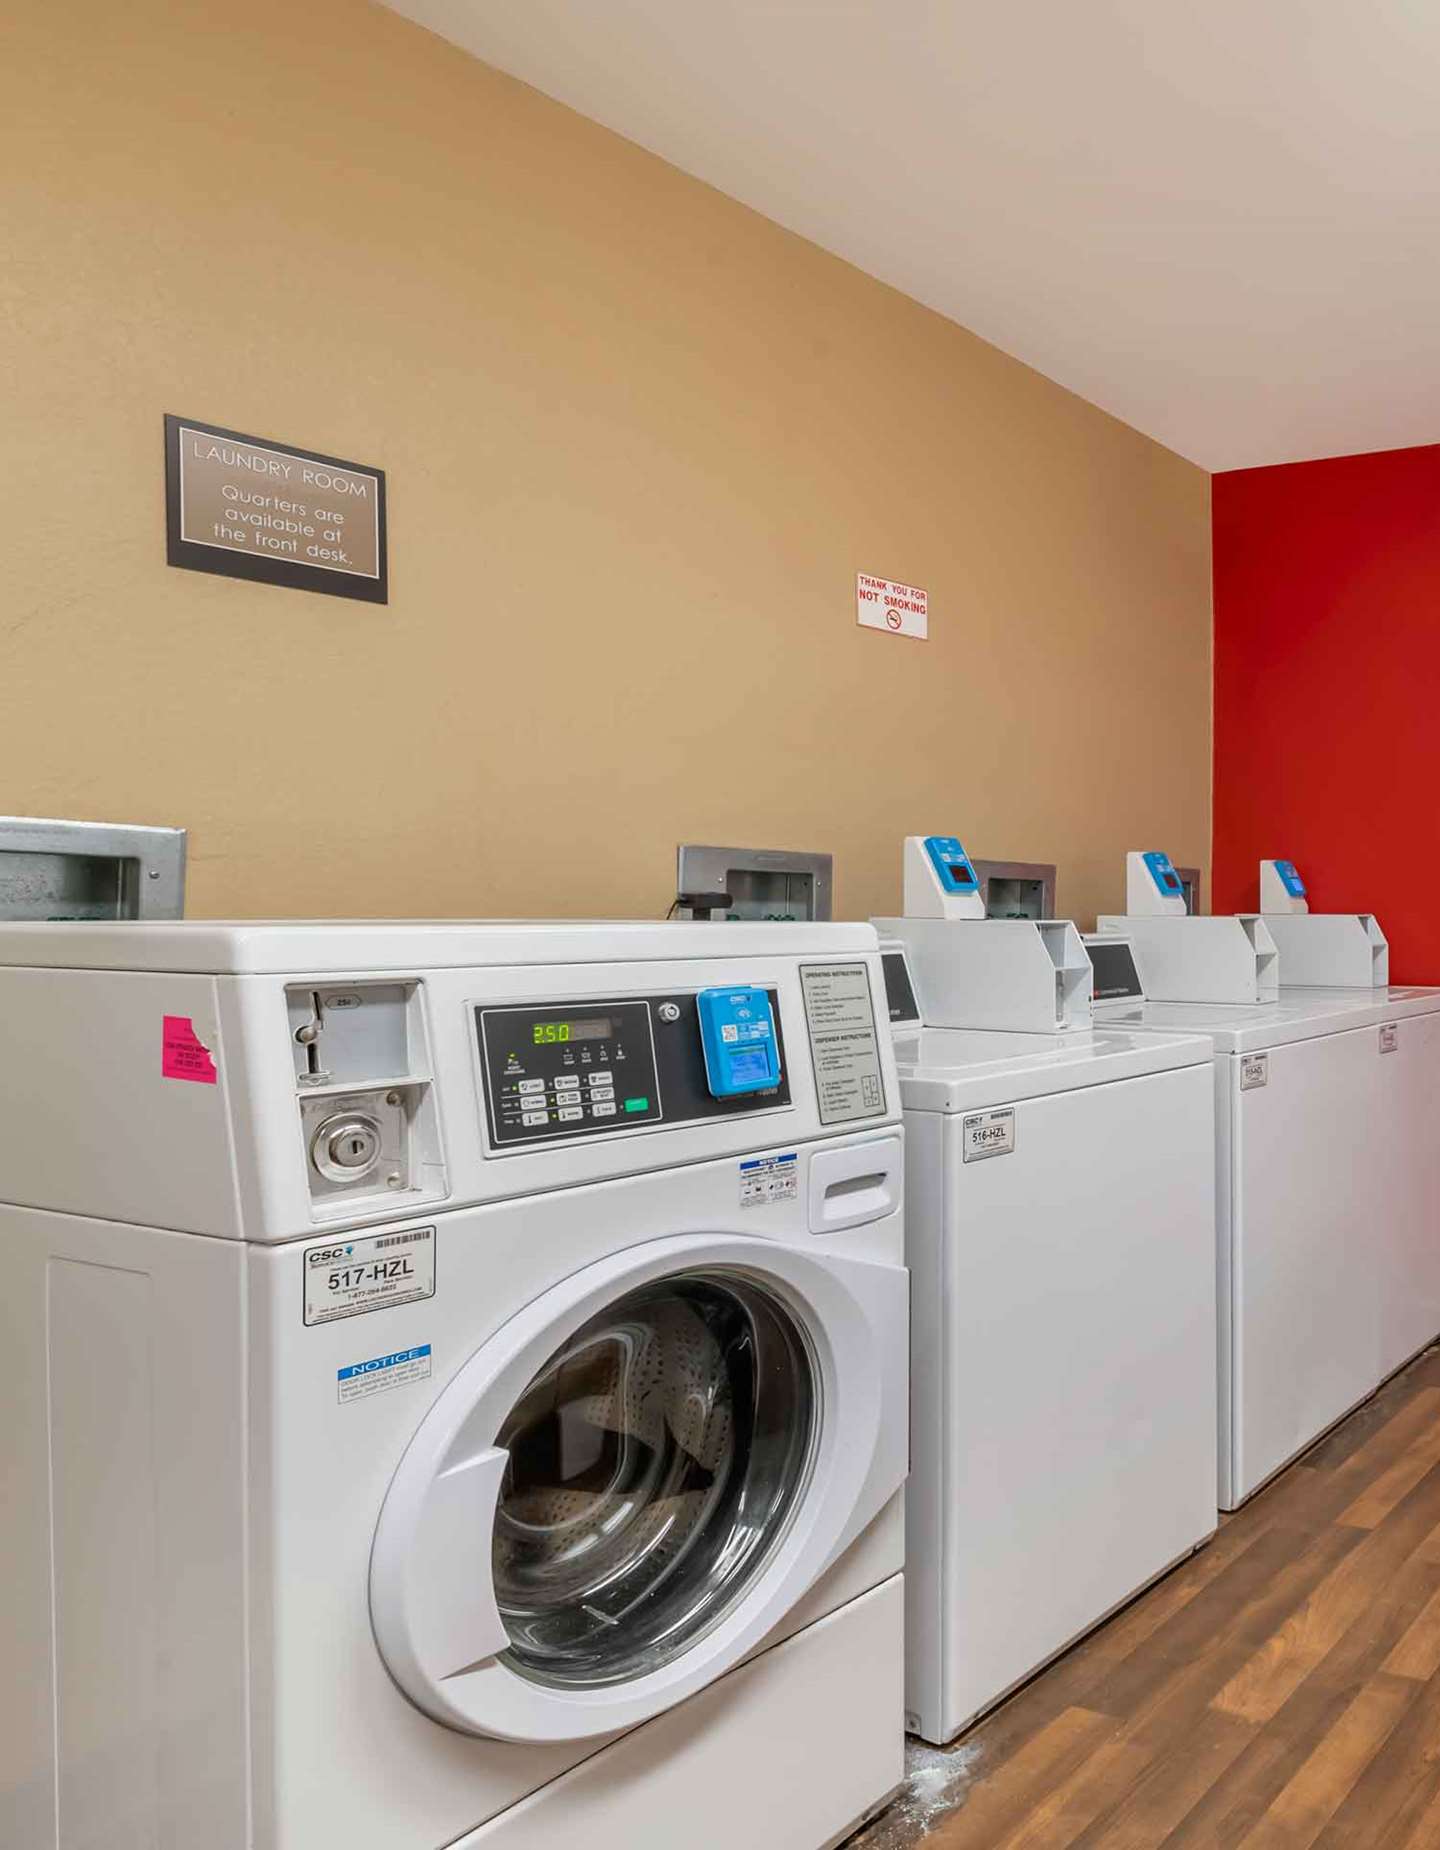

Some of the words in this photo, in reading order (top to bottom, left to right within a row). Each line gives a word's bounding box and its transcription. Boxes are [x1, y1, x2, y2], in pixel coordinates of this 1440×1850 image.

[193, 441, 292, 479] LAUNDRY
[302, 469, 367, 498] ROOM
[221, 484, 307, 517] Quarters
[314, 508, 345, 525] are
[224, 508, 315, 537] available
[323, 529, 341, 543] at
[212, 523, 246, 542] the
[255, 531, 298, 553] front
[306, 544, 353, 565] desk.
[859, 575, 887, 591] THANK
[892, 585, 908, 596] YOU
[910, 589, 926, 600] FOR
[859, 589, 880, 603] NOT
[883, 595, 926, 615] SMOKING
[972, 1127, 1006, 1143] 516-HZL
[308, 1248, 343, 1263] CSC
[328, 1259, 414, 1290] 517-HZL
[352, 1349, 420, 1376] NOTICE
